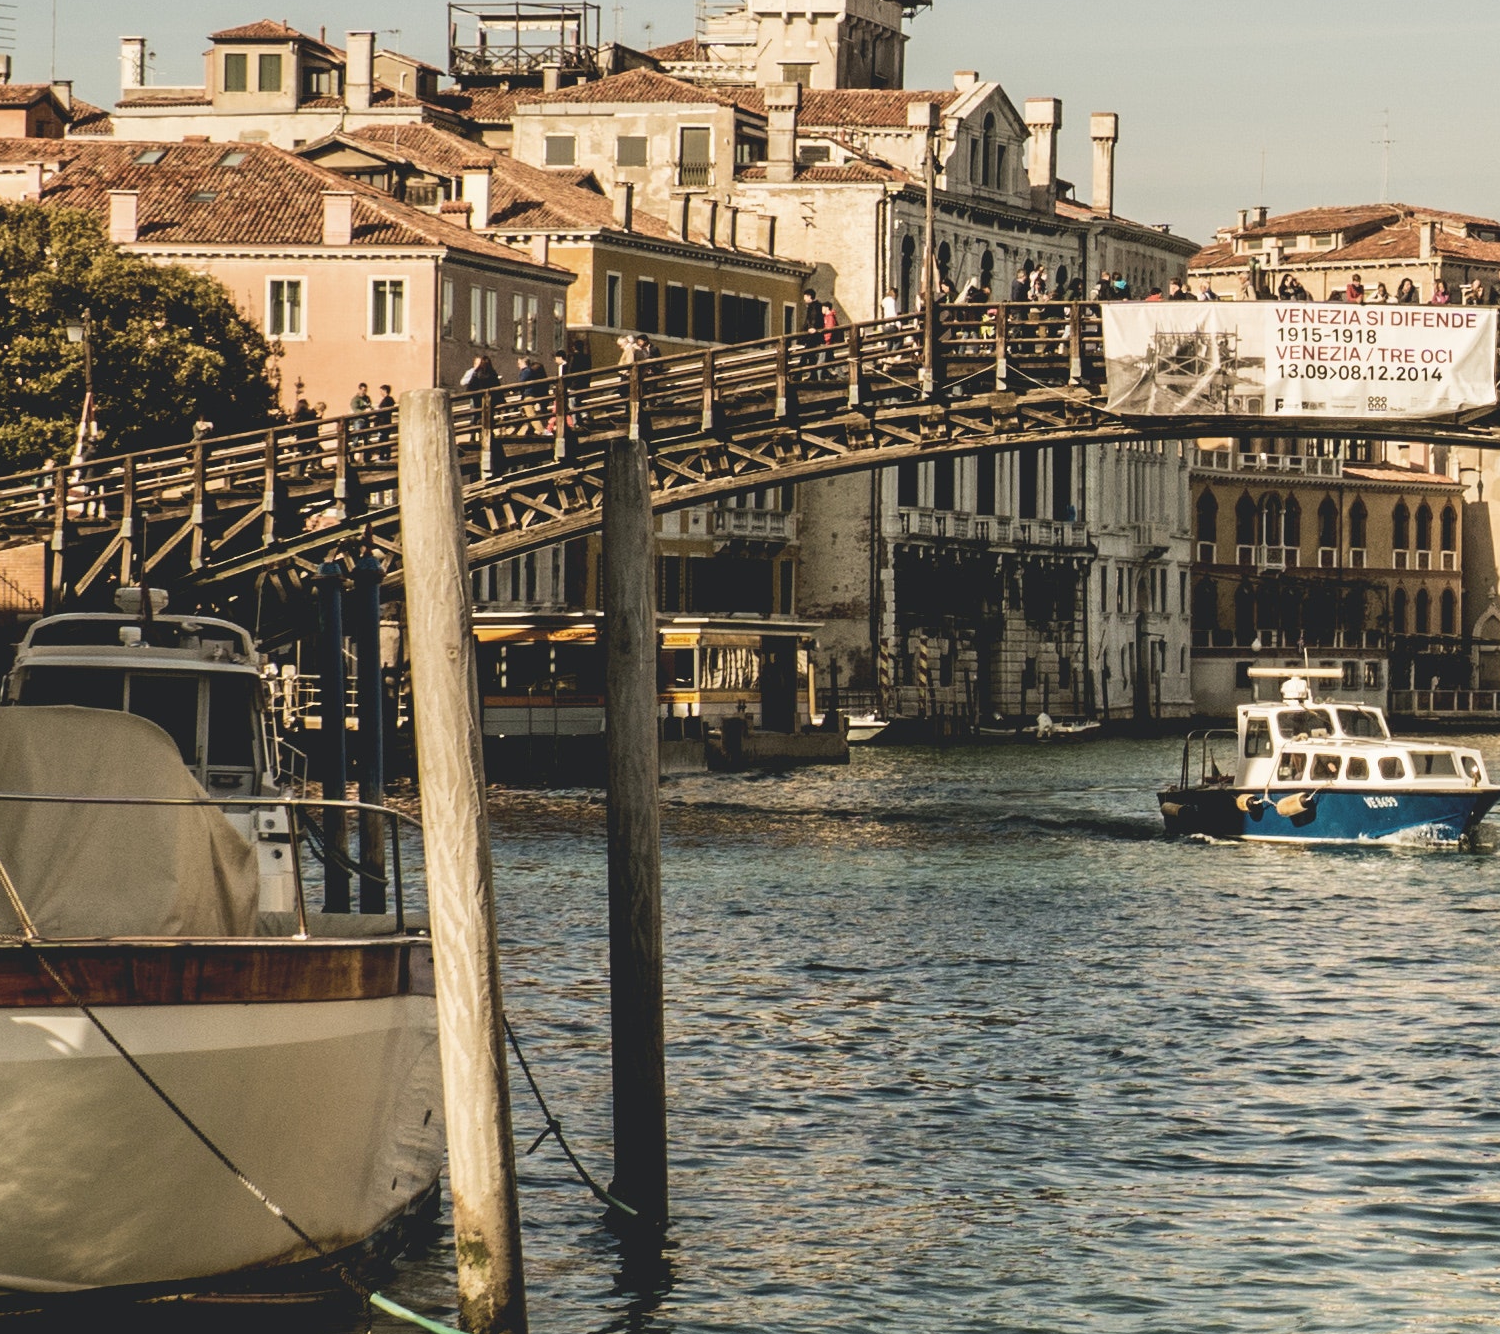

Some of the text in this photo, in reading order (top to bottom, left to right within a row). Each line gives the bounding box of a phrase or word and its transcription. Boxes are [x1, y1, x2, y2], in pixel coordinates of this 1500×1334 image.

[1275, 308, 1477, 328] VENEZIA SI DIFENDE
[1277, 327, 1377, 344] 1915-1918
[1275, 345, 1453, 364] VENEZIA / TRE OCI
[1277, 364, 1443, 382] 13.09>08.12.2014
